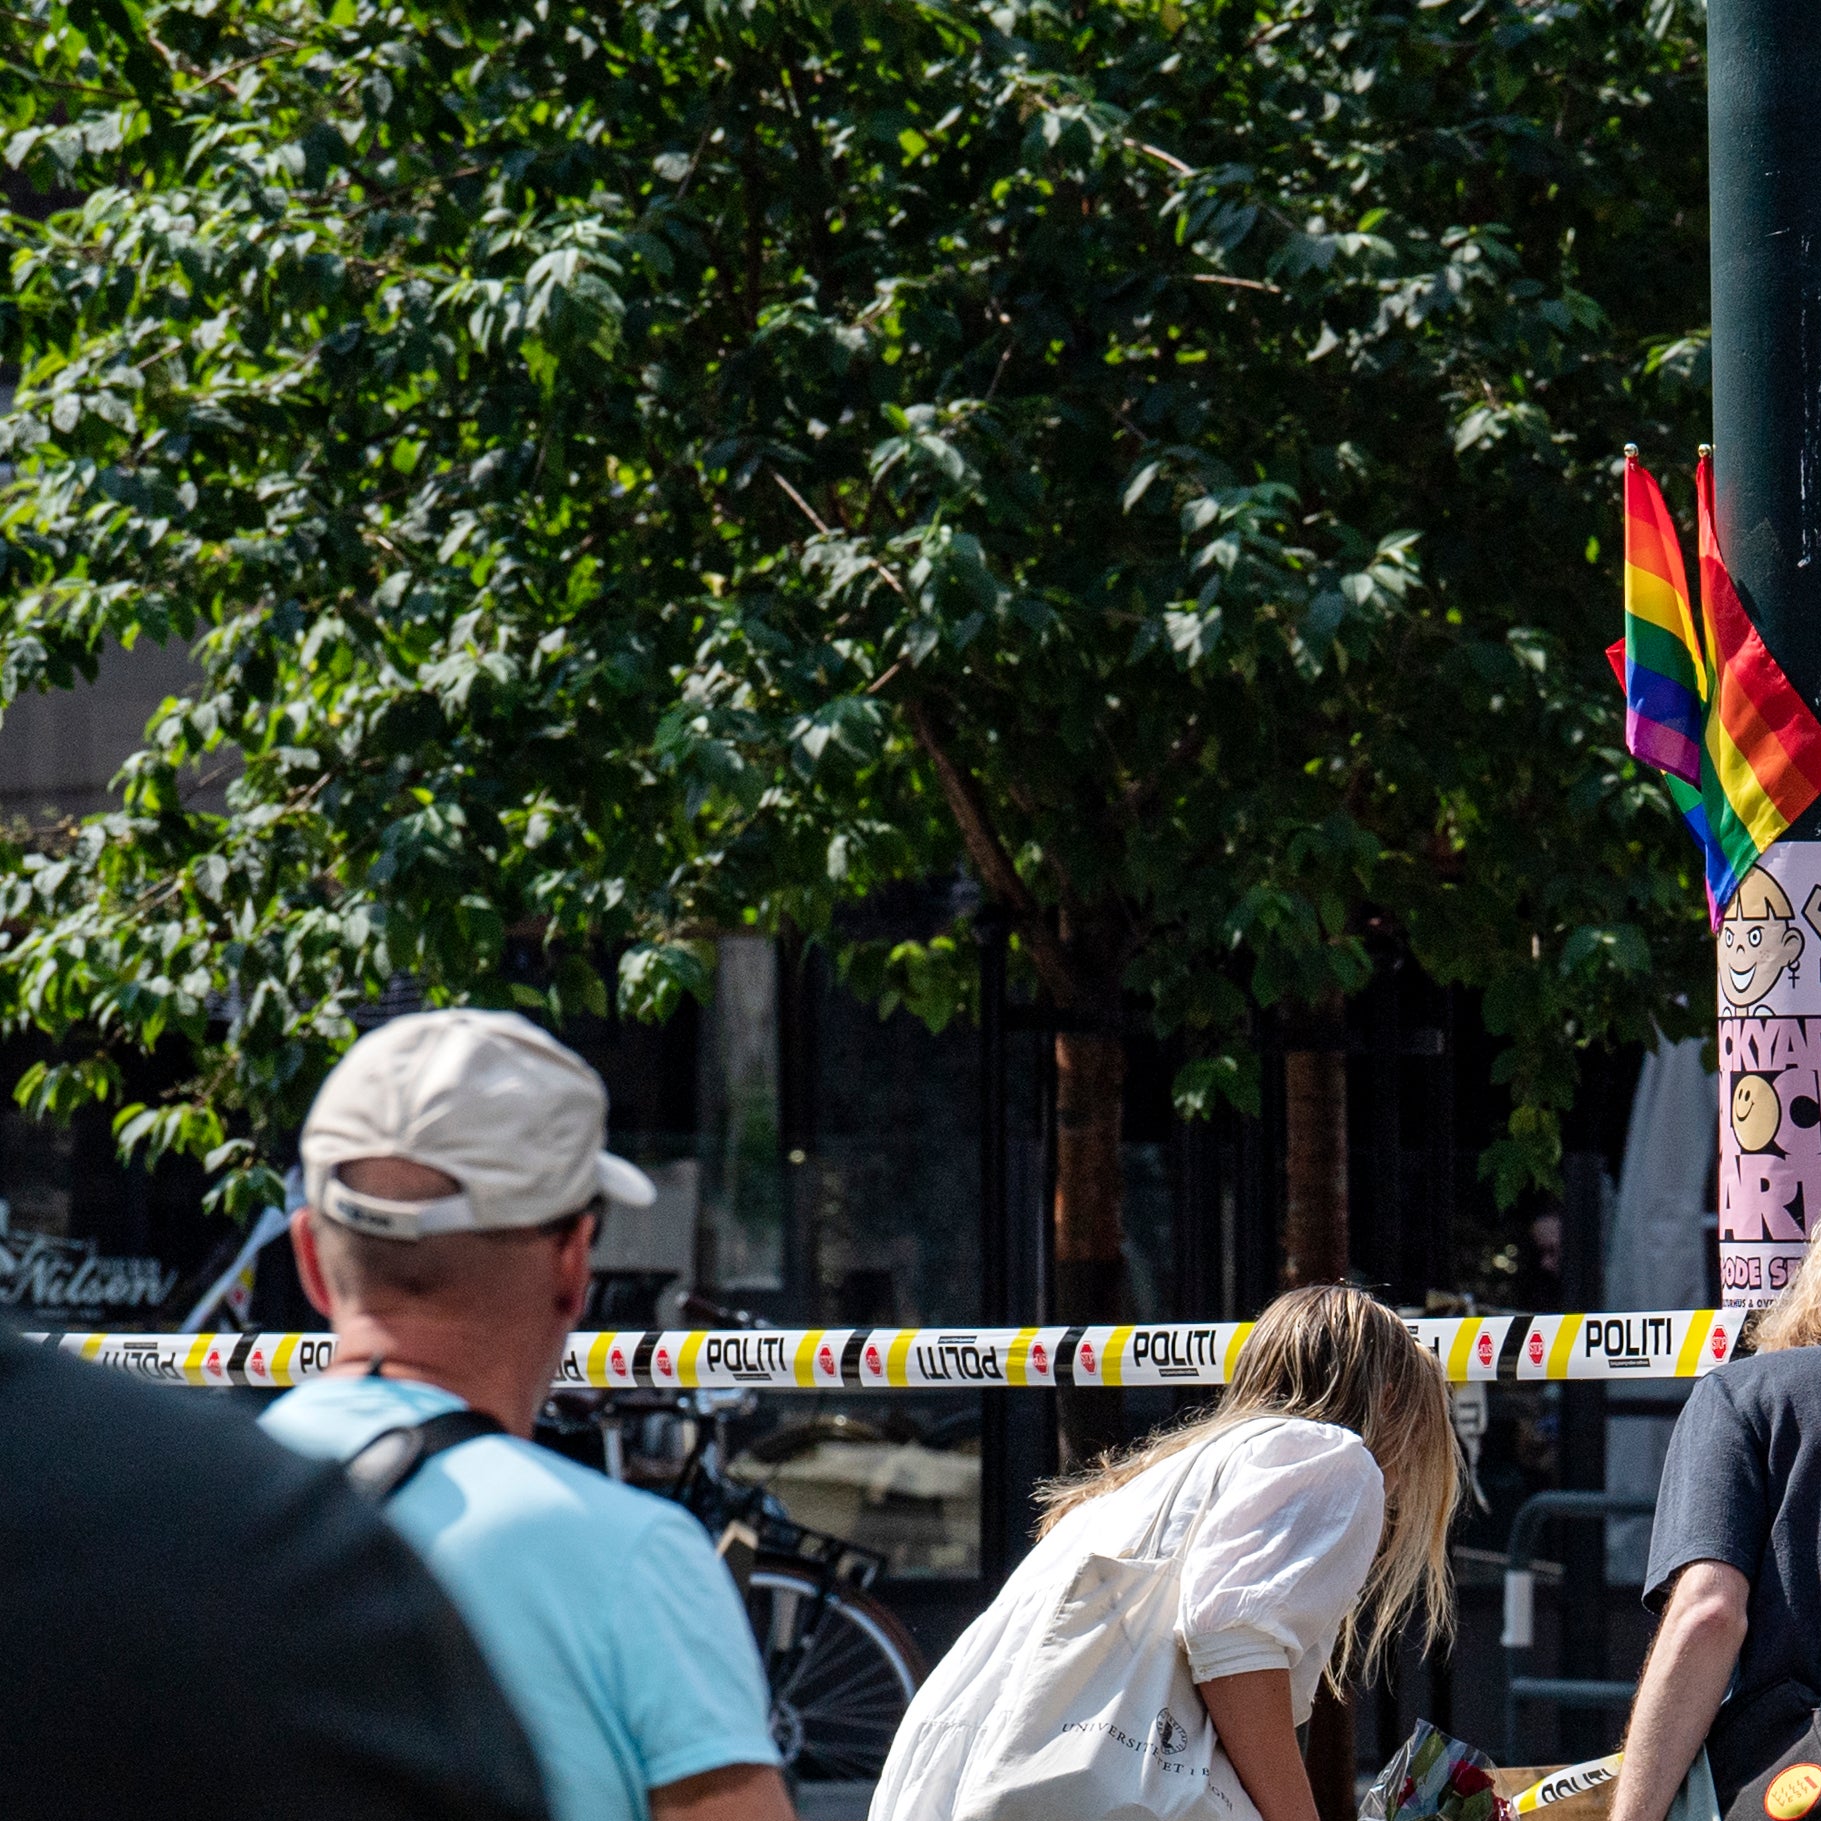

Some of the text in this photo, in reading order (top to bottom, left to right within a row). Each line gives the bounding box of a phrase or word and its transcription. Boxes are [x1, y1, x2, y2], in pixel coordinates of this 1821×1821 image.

[706, 1336, 787, 1372] POLITI
[1133, 1329, 1217, 1367] POLITI
[1585, 1318, 1672, 1357] POLITI
[917, 1346, 1004, 1379] POLITI
